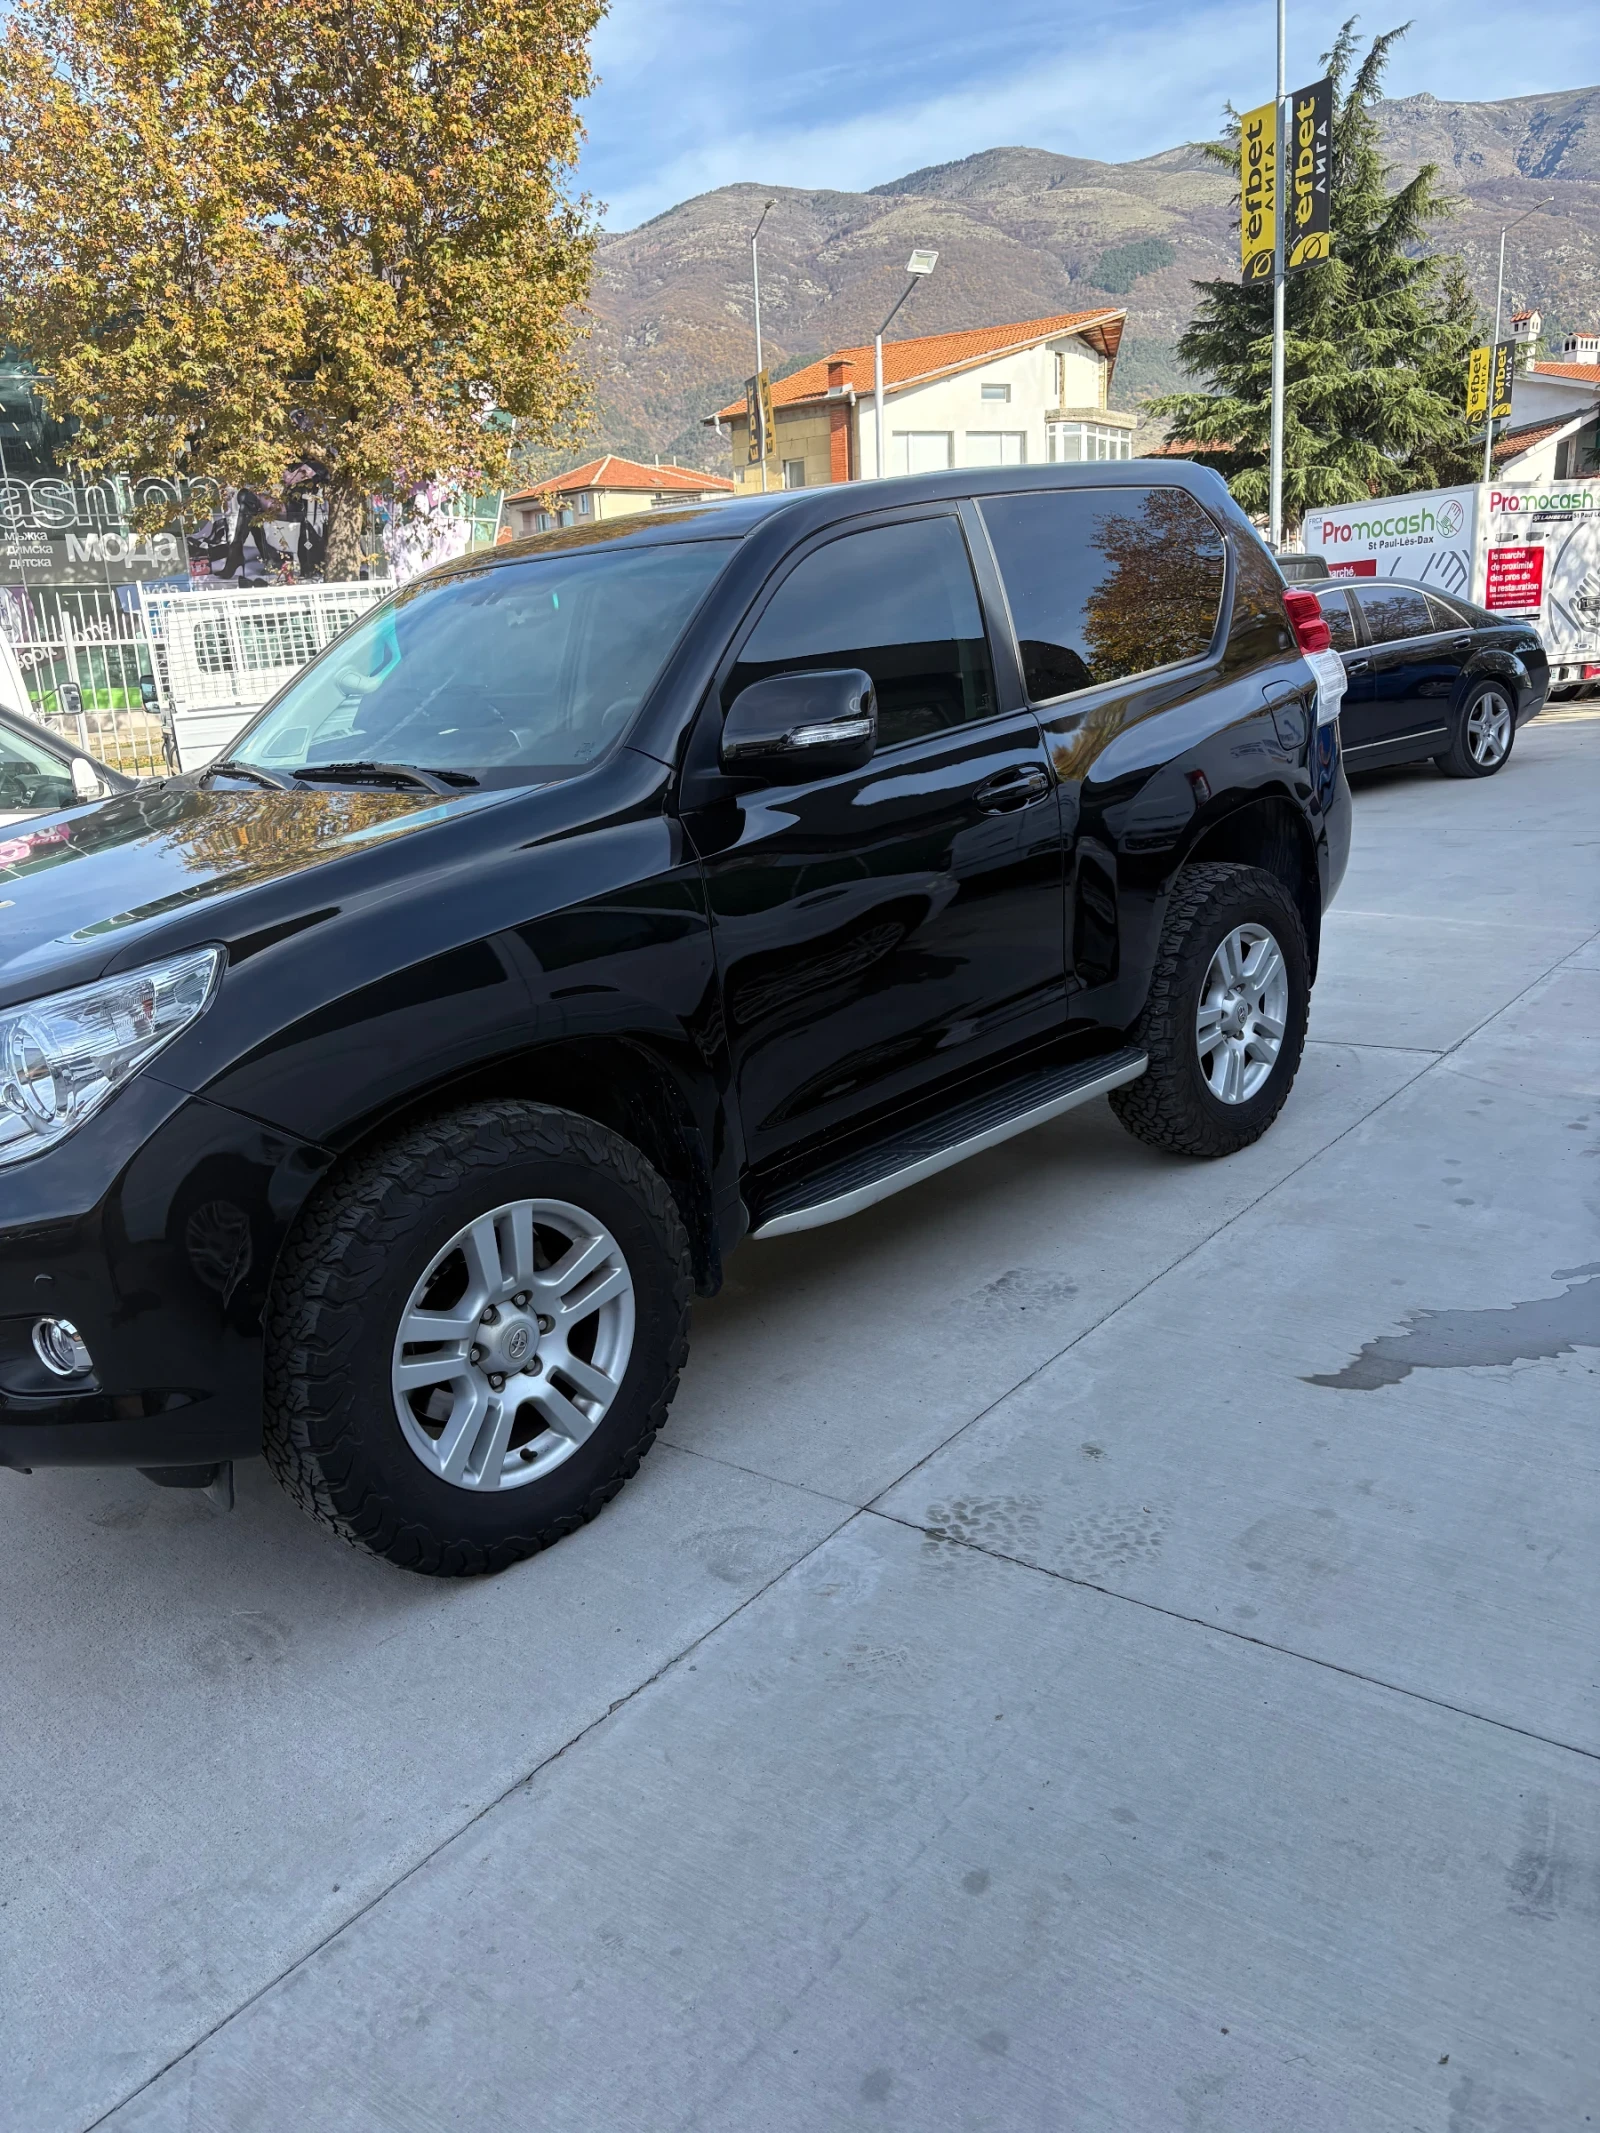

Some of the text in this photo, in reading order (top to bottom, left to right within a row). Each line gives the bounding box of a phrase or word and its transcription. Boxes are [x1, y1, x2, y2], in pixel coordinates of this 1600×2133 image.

[1246, 118, 1262, 239] efbet
[1295, 97, 1315, 224] efbet
[1471, 353, 1481, 404] efbet
[1496, 346, 1507, 400] efbet
[1490, 489, 1593, 512] Promocash
[1322, 508, 1435, 544] Promocash
[1368, 541, 1377, 550] St
[1498, 582, 1539, 592] restauration
